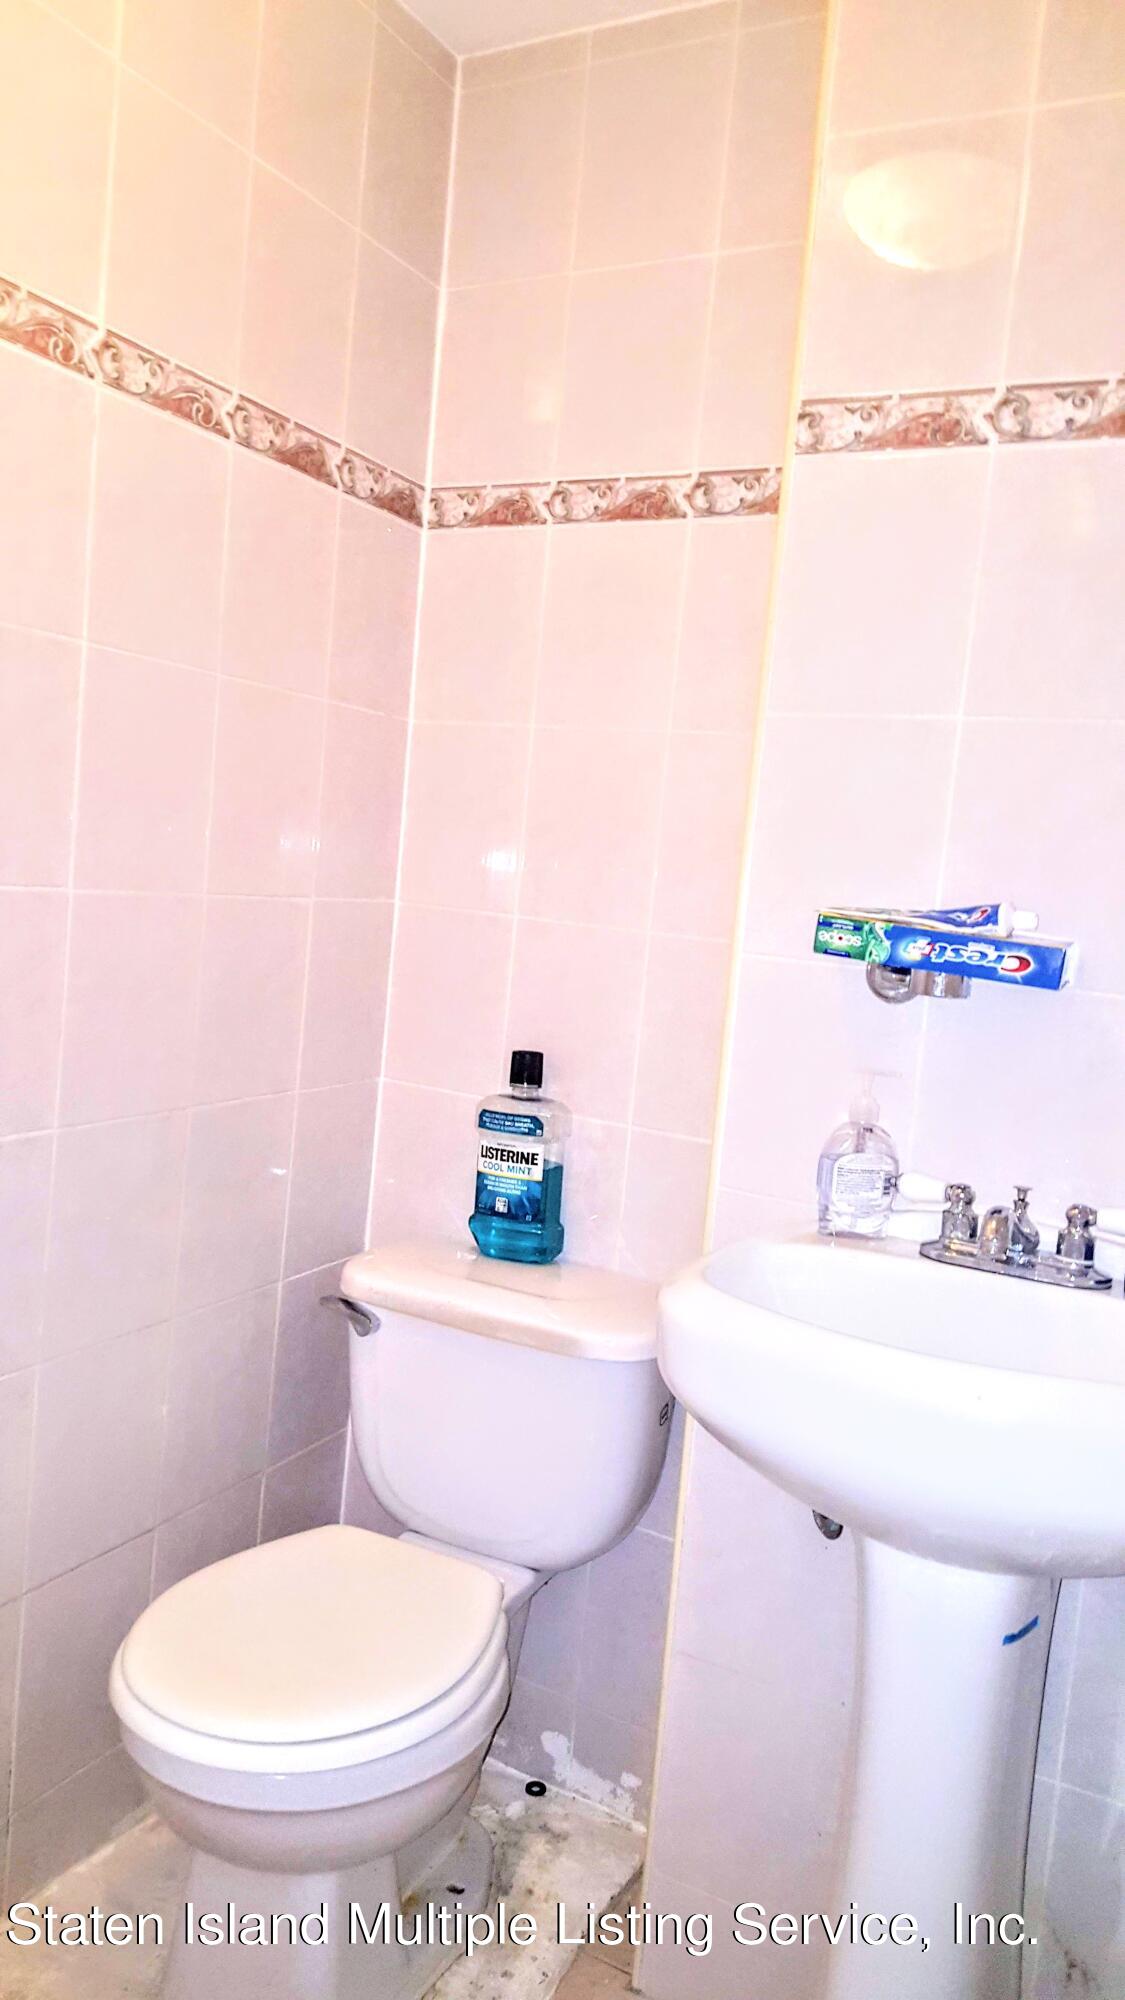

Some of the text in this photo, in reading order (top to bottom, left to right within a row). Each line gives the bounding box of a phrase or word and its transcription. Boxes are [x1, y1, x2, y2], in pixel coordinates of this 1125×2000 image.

[818, 930, 862, 947] scope
[931, 945, 1032, 975] Crest
[481, 1145, 539, 1166] LISTERINE
[482, 1160, 533, 1176] COOL MINT
